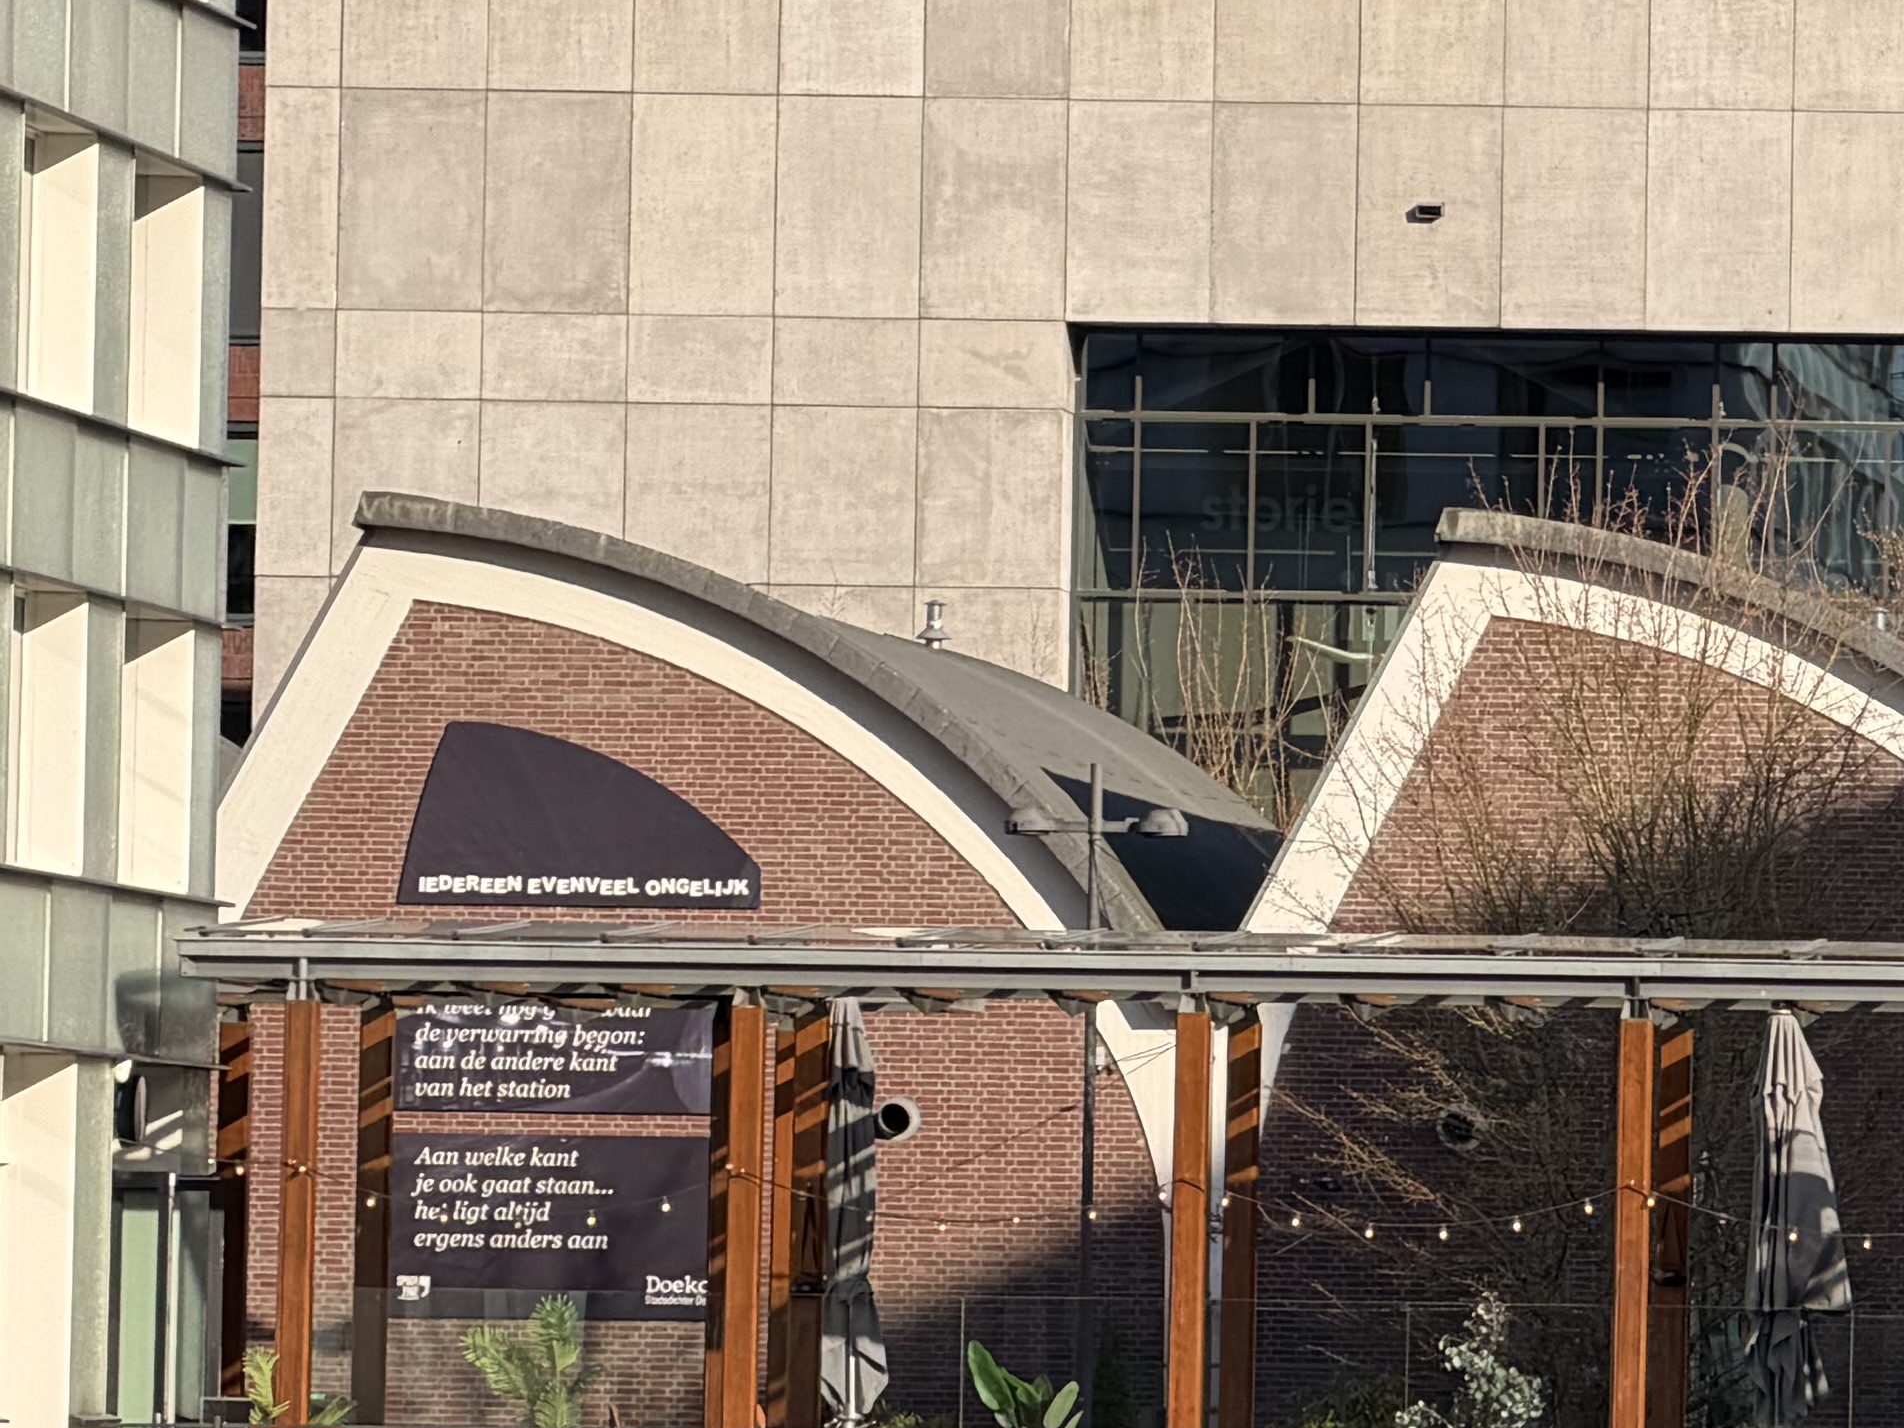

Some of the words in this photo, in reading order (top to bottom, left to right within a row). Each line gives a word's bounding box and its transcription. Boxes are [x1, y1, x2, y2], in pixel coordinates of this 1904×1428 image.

[418, 874, 523, 895] IEDEREEN
[526, 875, 640, 896] EVENVEEL
[644, 877, 750, 898] ONGELIJK
[414, 1021, 440, 1043] de
[445, 1025, 568, 1050] verwarring
[573, 1024, 646, 1050] begon:
[414, 1054, 456, 1070] aan
[460, 1049, 486, 1070] de
[490, 1049, 564, 1071] andere
[568, 1051, 619, 1072] kant
[414, 1081, 455, 1098] van
[459, 1077, 492, 1098] het
[496, 1078, 572, 1099] station
[414, 1146, 459, 1166] Aan
[464, 1145, 526, 1167] welke
[529, 1146, 580, 1168] kant
[411, 1172, 435, 1198] je
[438, 1172, 478, 1194] ook
[481, 1175, 532, 1198] gaat
[535, 1176, 614, 1195] staan...
[453, 1200, 489, 1225] ligt
[493, 1201, 551, 1227] altijd
[414, 1233, 485, 1253] ergens
[489, 1228, 563, 1250] anders
[567, 1233, 609, 1251] aan
